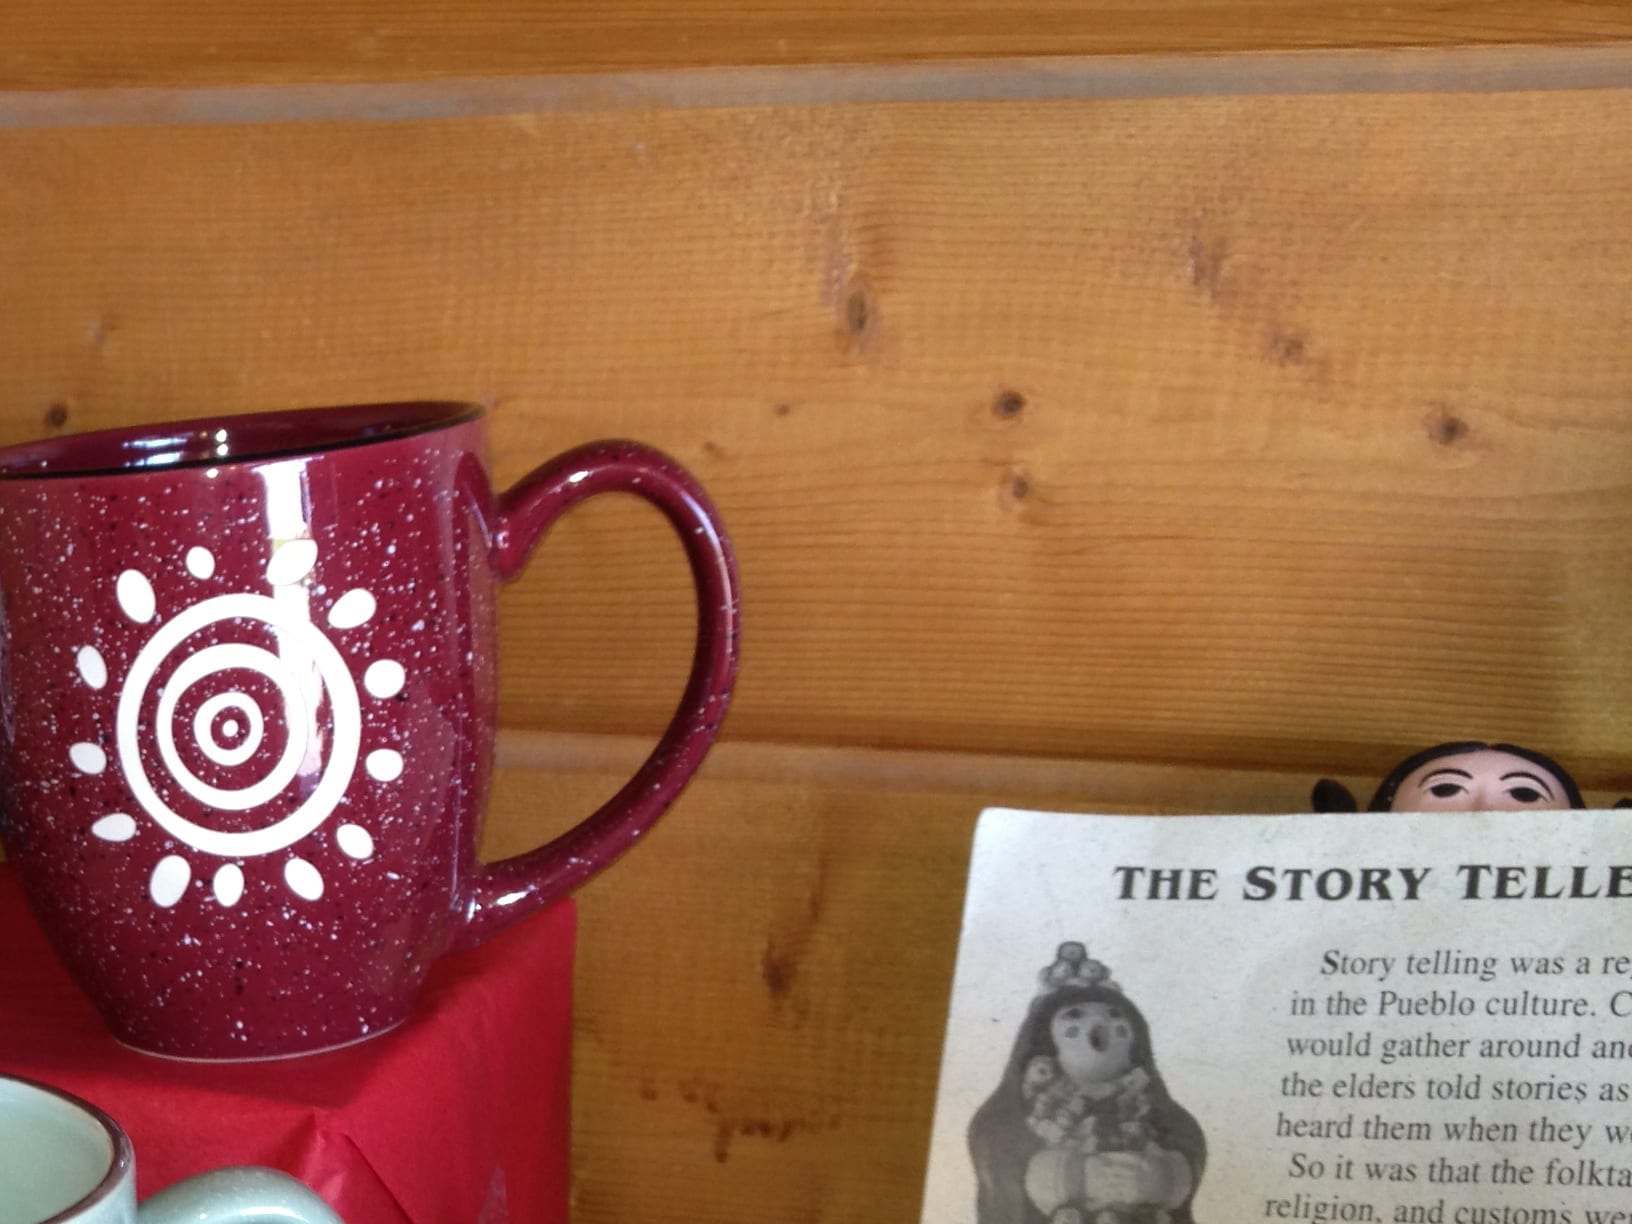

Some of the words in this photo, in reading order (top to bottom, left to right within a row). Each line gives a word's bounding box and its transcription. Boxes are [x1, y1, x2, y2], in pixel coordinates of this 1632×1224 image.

[1113, 867, 1217, 899] THE
[1243, 866, 1431, 902] STORY
[1319, 949, 1397, 983] Story
[1406, 949, 1499, 983] telling
[1509, 956, 1565, 975] was
[1574, 956, 1591, 976] a
[1601, 955, 1632, 980] re
[1290, 989, 1316, 1017] in
[1326, 990, 1368, 1017] the
[1378, 989, 1476, 1017] Pueblo
[1484, 989, 1597, 1018] culture.
[1287, 1031, 1372, 1058] would
[1380, 1031, 1472, 1065] gather
[1479, 1032, 1582, 1059] around
[1590, 1039, 1632, 1060] an
[1281, 1071, 1324, 1098] the
[1332, 1072, 1416, 1100] elders
[1426, 1073, 1482, 1101] told
[1491, 1073, 1588, 1103] stories
[1598, 1082, 1630, 1102] as
[1275, 1111, 1354, 1140] heard
[1363, 1114, 1432, 1141] them
[1443, 1115, 1518, 1143] when
[1528, 1116, 1593, 1151] they
[1288, 1152, 1325, 1179] So
[1334, 1154, 1354, 1181] it
[1364, 1162, 1417, 1183] was
[1428, 1156, 1481, 1185] that
[1491, 1157, 1535, 1185] the
[1392, 1198, 1445, 1224] and
